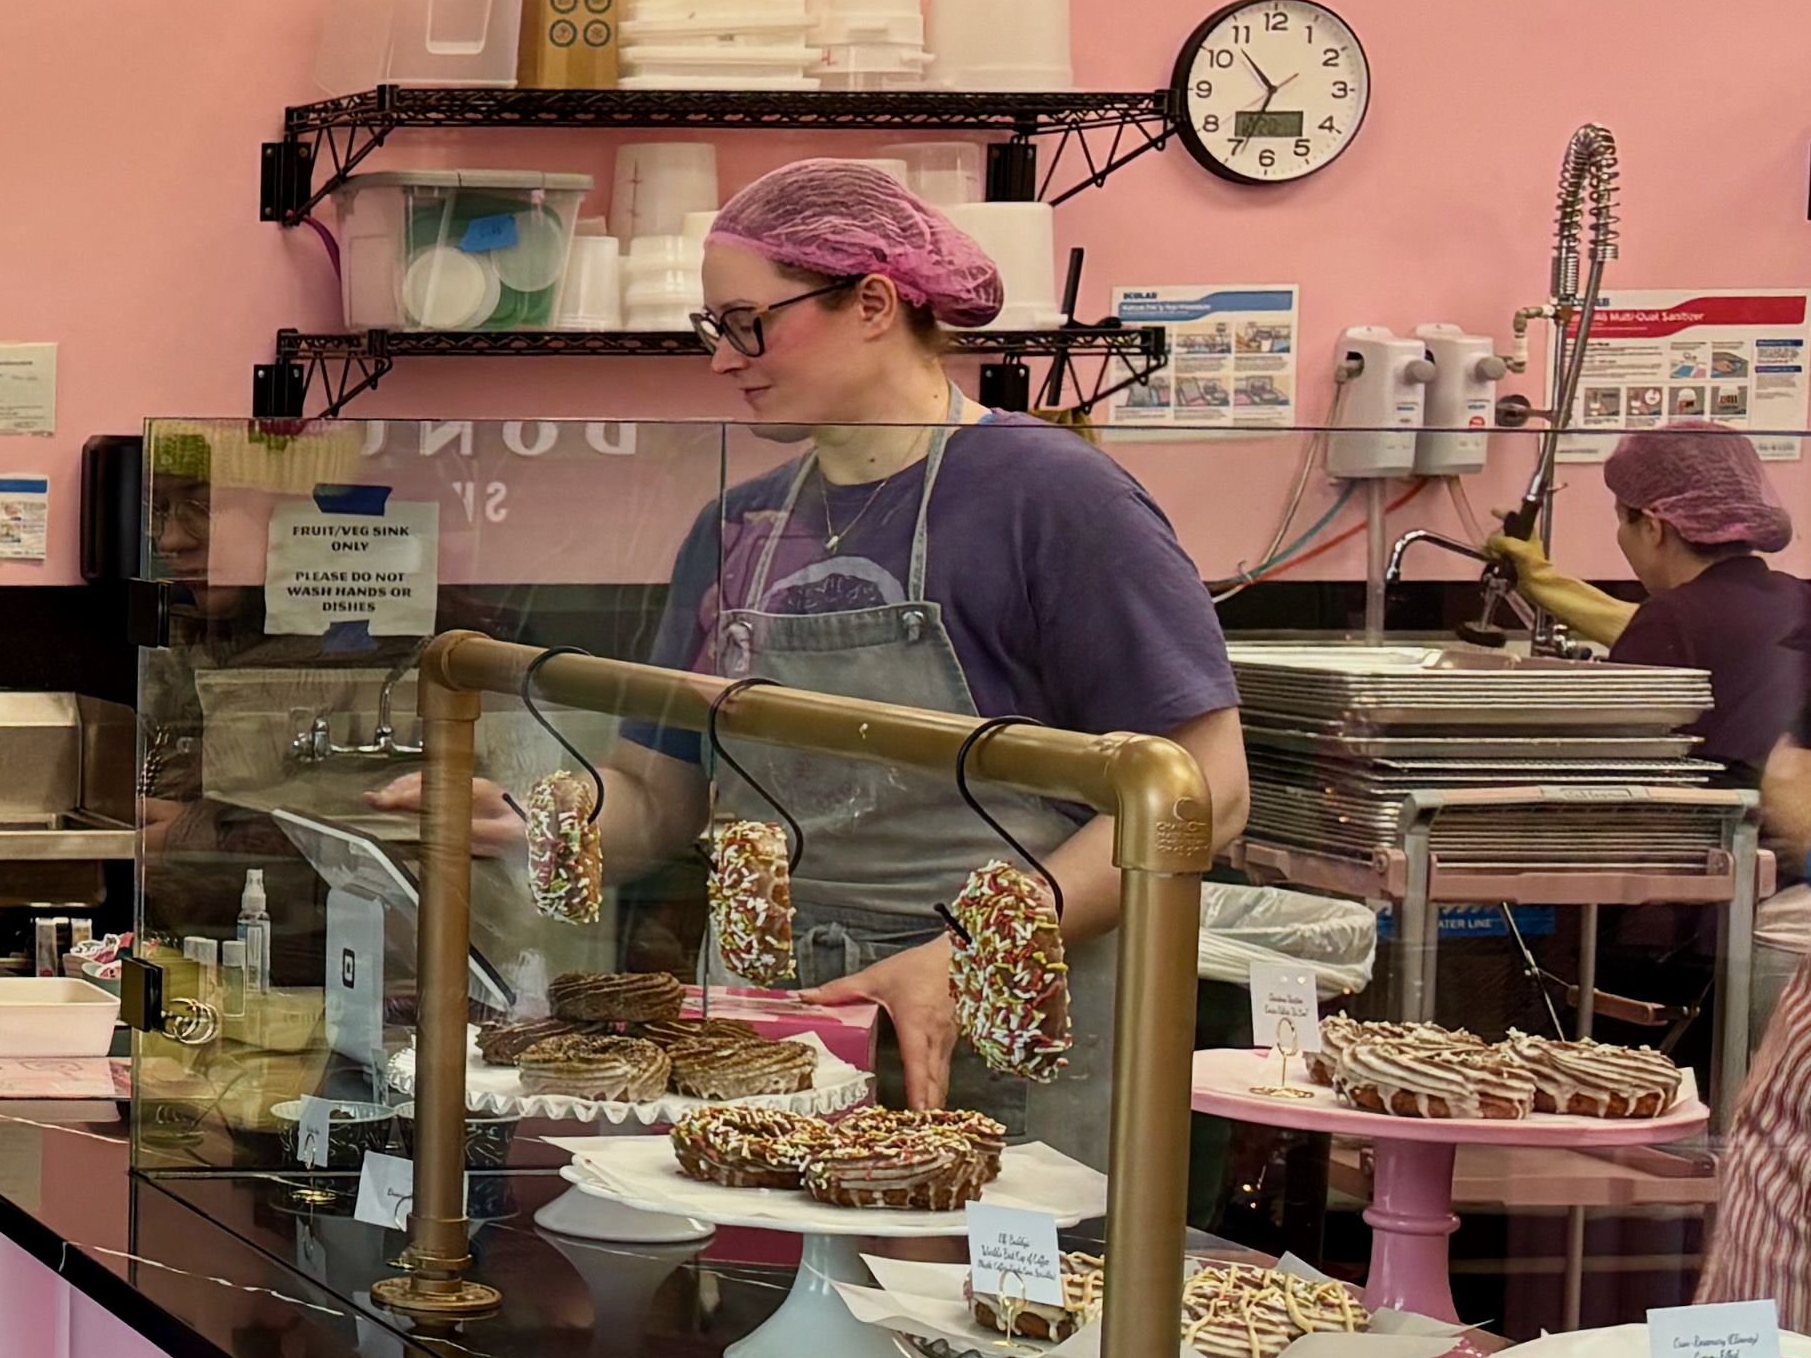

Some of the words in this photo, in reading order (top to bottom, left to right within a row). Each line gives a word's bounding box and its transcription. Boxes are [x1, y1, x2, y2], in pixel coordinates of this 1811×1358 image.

[1264, 12, 1289, 31] 12
[1232, 25, 1250, 44] 11
[1209, 49, 1233, 68] 10
[1322, 48, 1339, 67] 2
[1195, 80, 1212, 98] 9
[1331, 81, 1348, 98] 3
[1202, 114, 1219, 132] 8
[1318, 116, 1335, 133] 4
[1227, 139, 1244, 156] 7
[1293, 139, 1311, 156] 5
[1259, 149, 1275, 167] 6
[292, 526, 369, 537] FRUIT/VEG
[373, 526, 409, 536] SINK
[331, 541, 369, 551] ONLY
[295, 572, 347, 582] PLEASE
[351, 572, 372, 582] DO
[376, 573, 405, 582] NOT
[287, 587, 331, 597] WASH
[335, 587, 386, 597] HANDS
[390, 588, 411, 597] OR
[322, 602, 376, 612] DISHES
[1438, 916, 1466, 929] ATER
[1468, 916, 1492, 929] LINE
